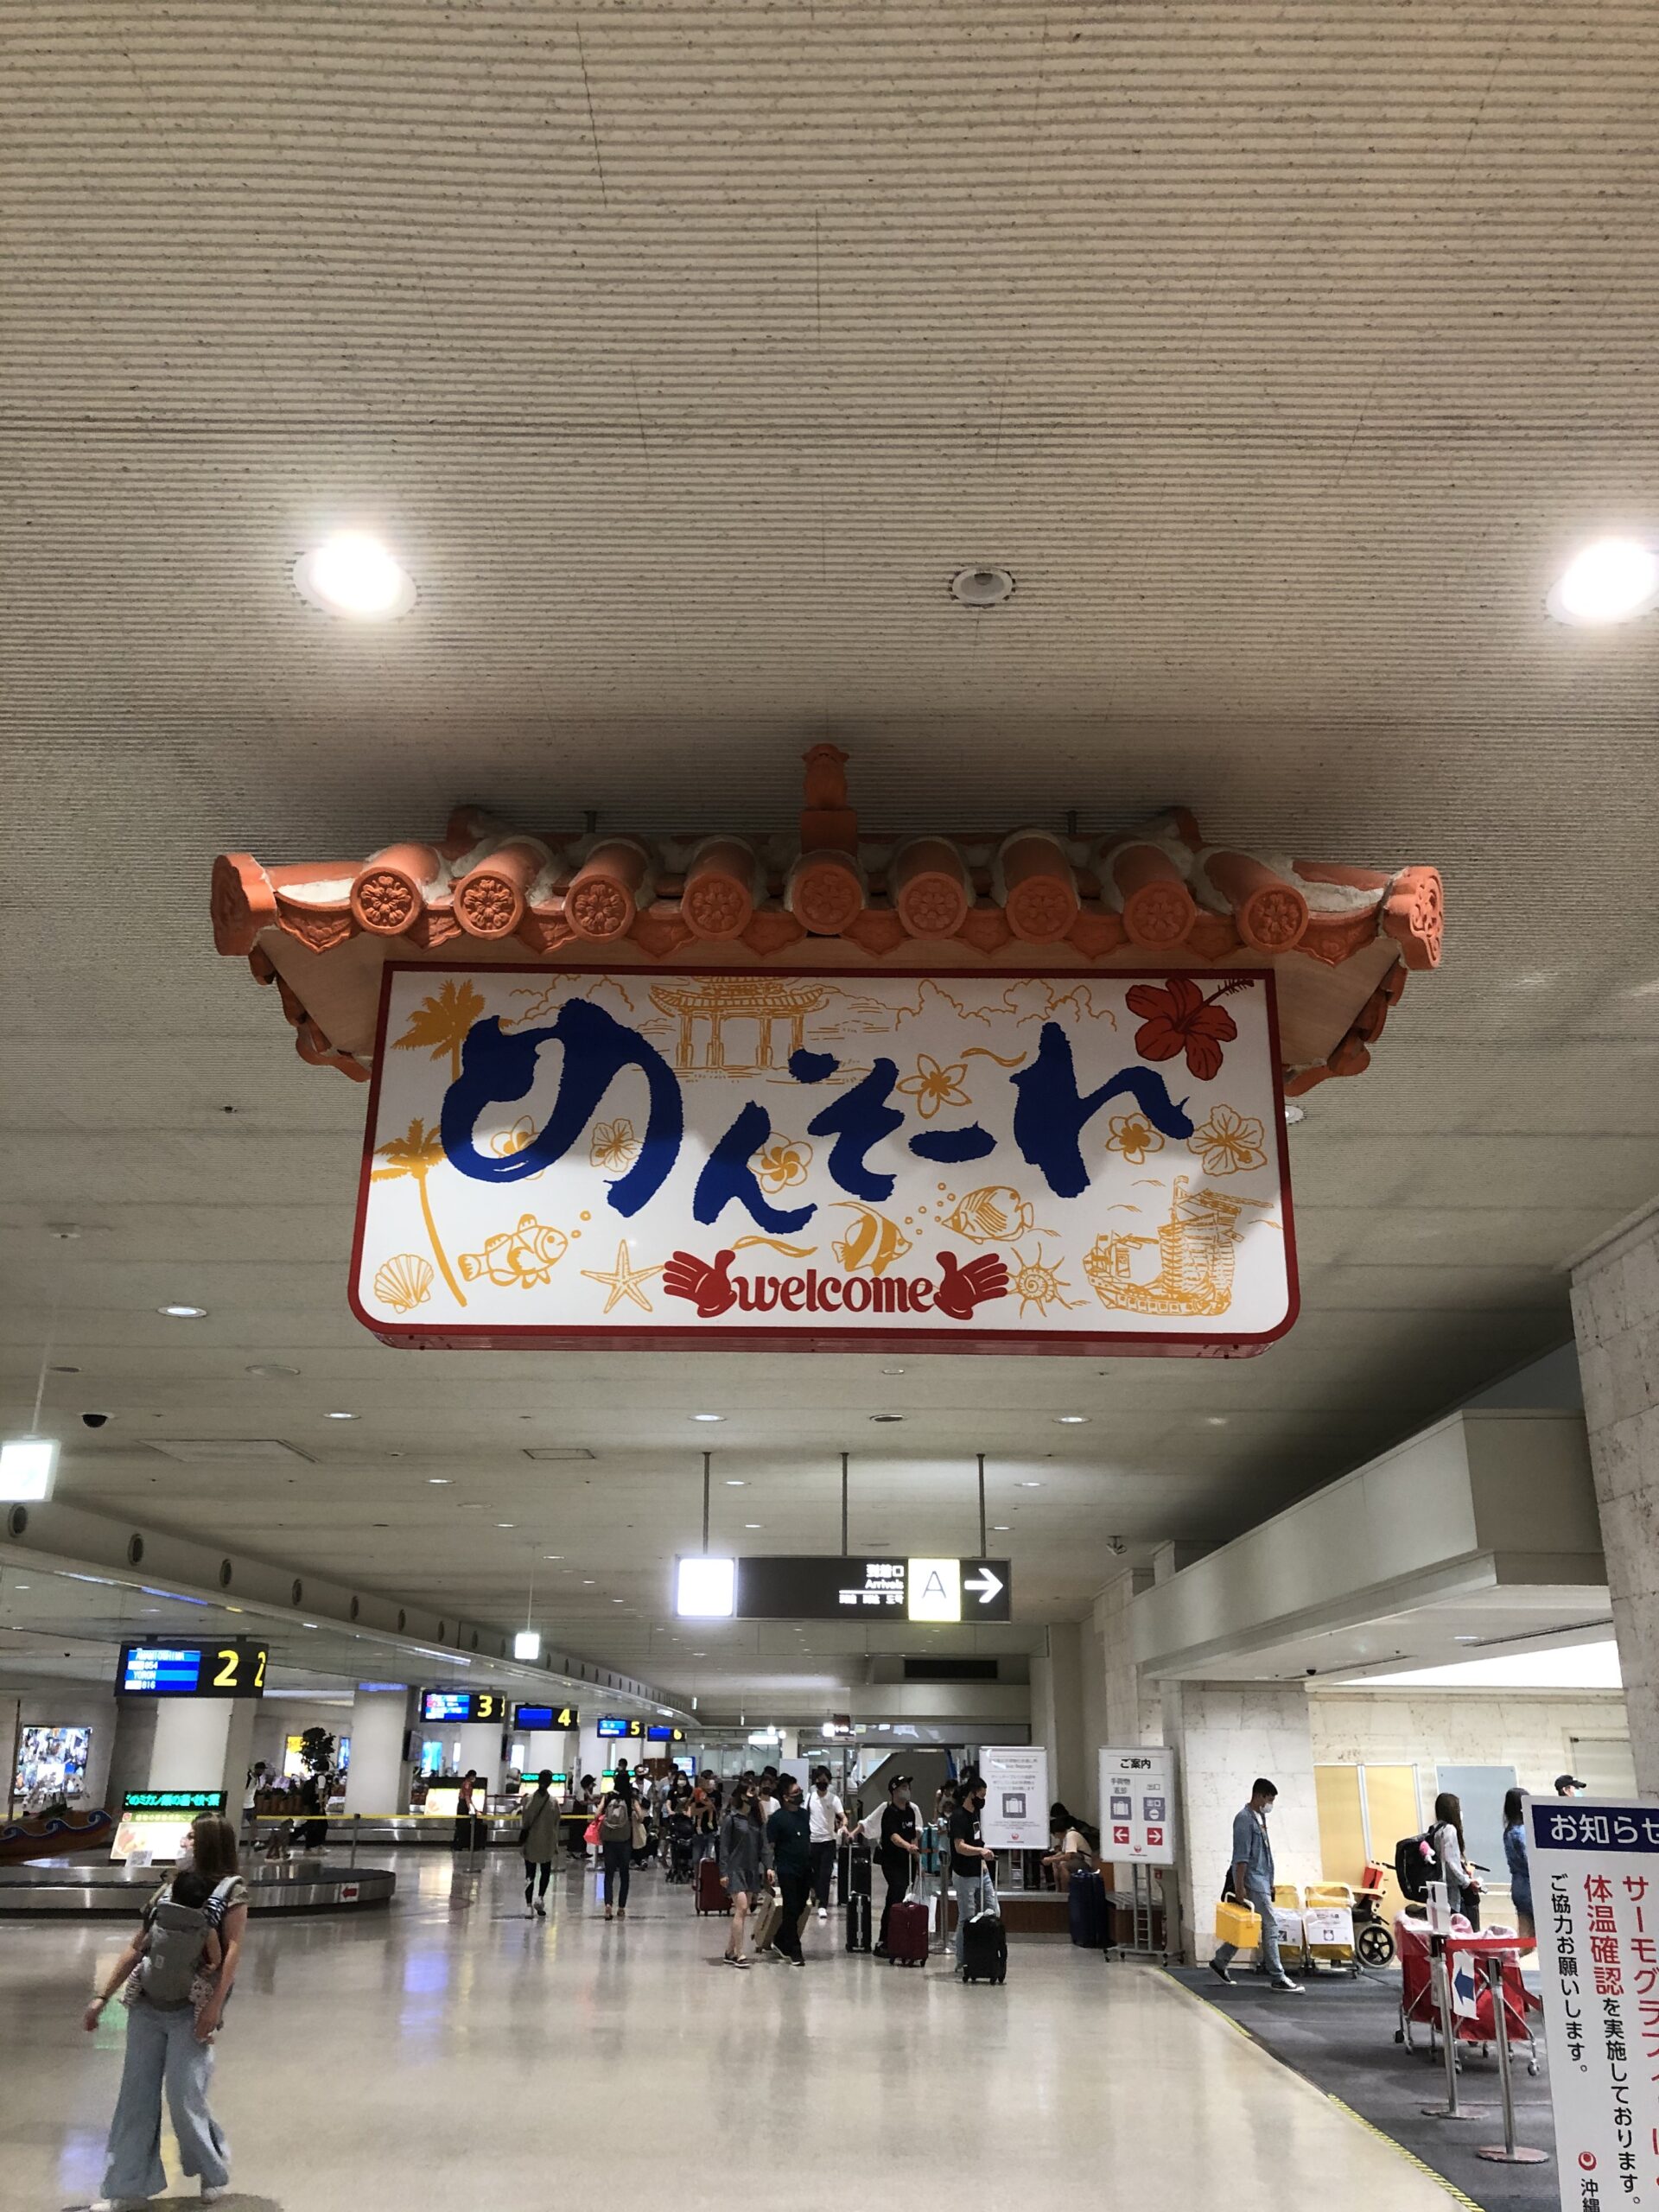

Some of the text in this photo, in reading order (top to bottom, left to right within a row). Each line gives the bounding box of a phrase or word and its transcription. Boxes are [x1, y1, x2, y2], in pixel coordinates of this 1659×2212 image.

[442, 999, 1194, 1234] めんそーれ
[733, 1269, 934, 1313] welcome
[865, 1579, 904, 1589] Arrivals
[922, 1570, 947, 1599] A
[213, 1649, 239, 1687] 2
[477, 1694, 493, 1718] 3
[557, 1708, 572, 1726] 4
[630, 1720, 640, 1736] 5
[673, 1728, 683, 1740] 6
[1120, 1758, 1152, 1770] ご案内
[1550, 1814, 1659, 1845] お知らせ
[1551, 1872, 1588, 2073] ご協力お願いします。
